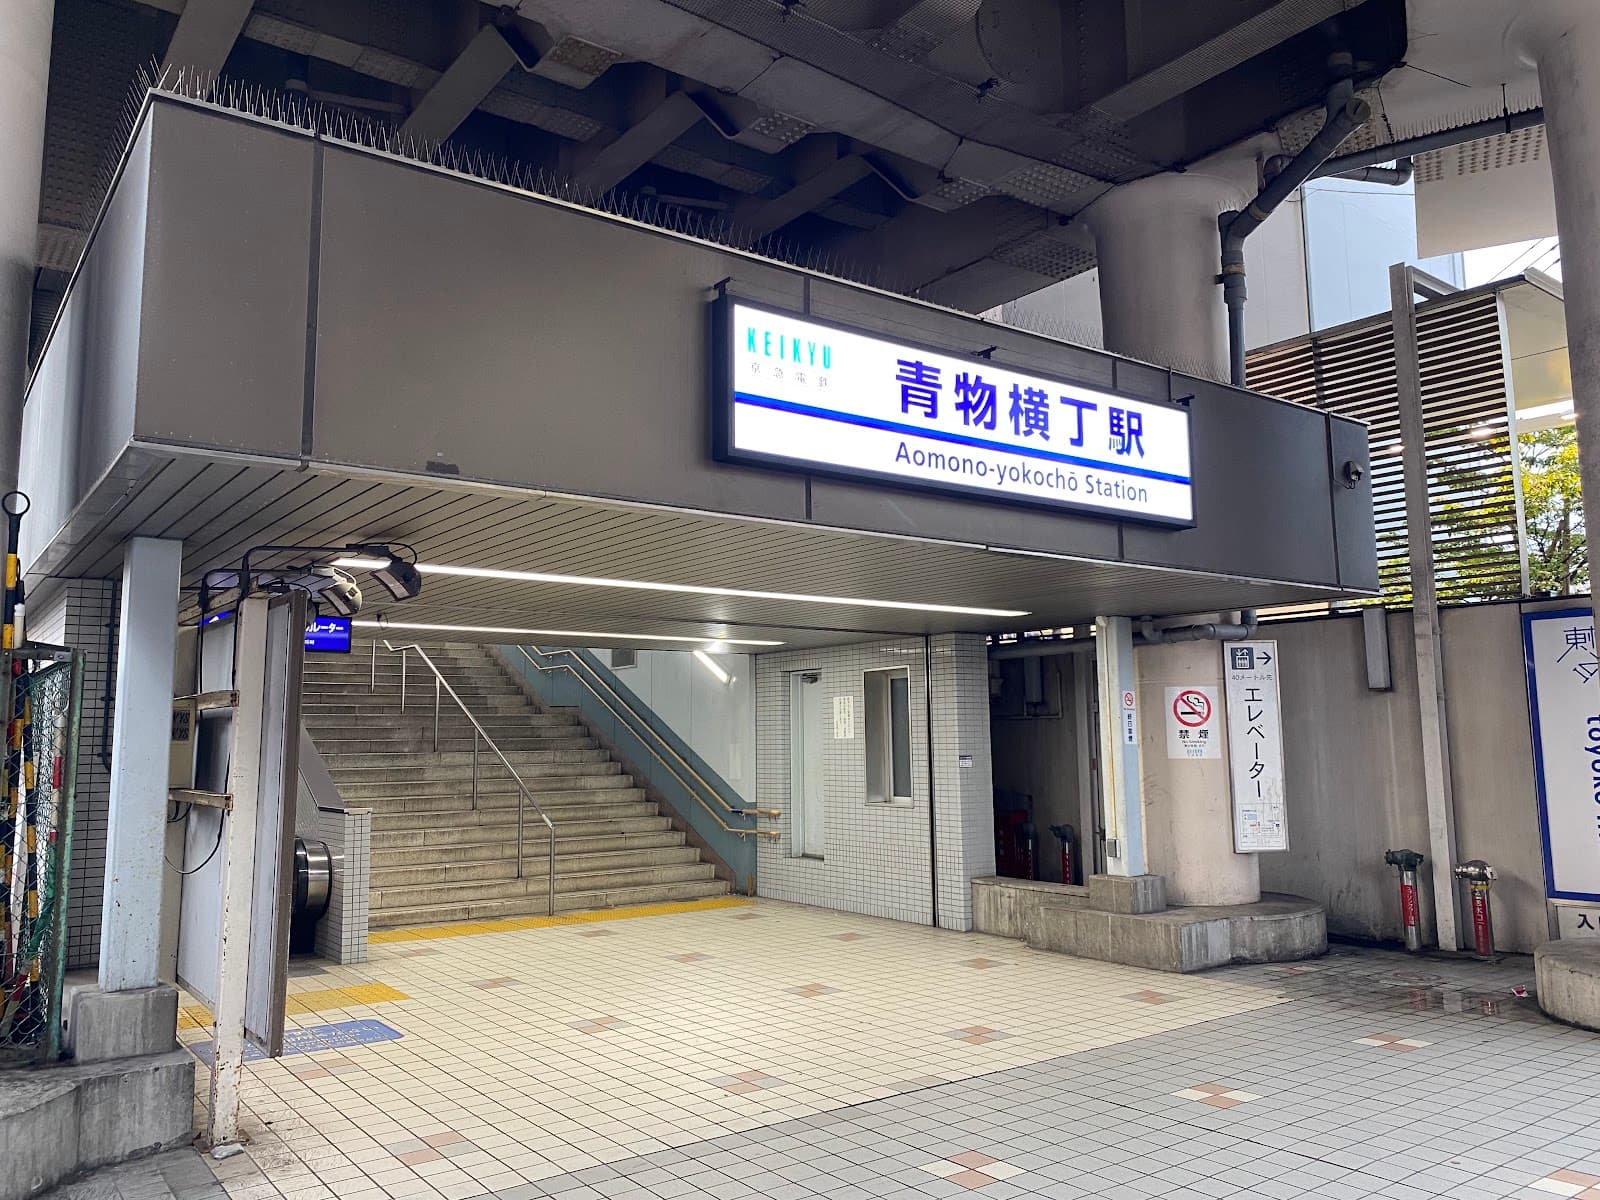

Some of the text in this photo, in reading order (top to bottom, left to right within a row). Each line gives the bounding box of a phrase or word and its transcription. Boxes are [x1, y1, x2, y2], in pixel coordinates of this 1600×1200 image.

[747, 326, 831, 370] KEIKYU
[896, 359, 1145, 458] 青物横丁駅
[895, 441, 1148, 503] Aomono-yokochō Station
[1244, 688, 1266, 798] エレベーター
